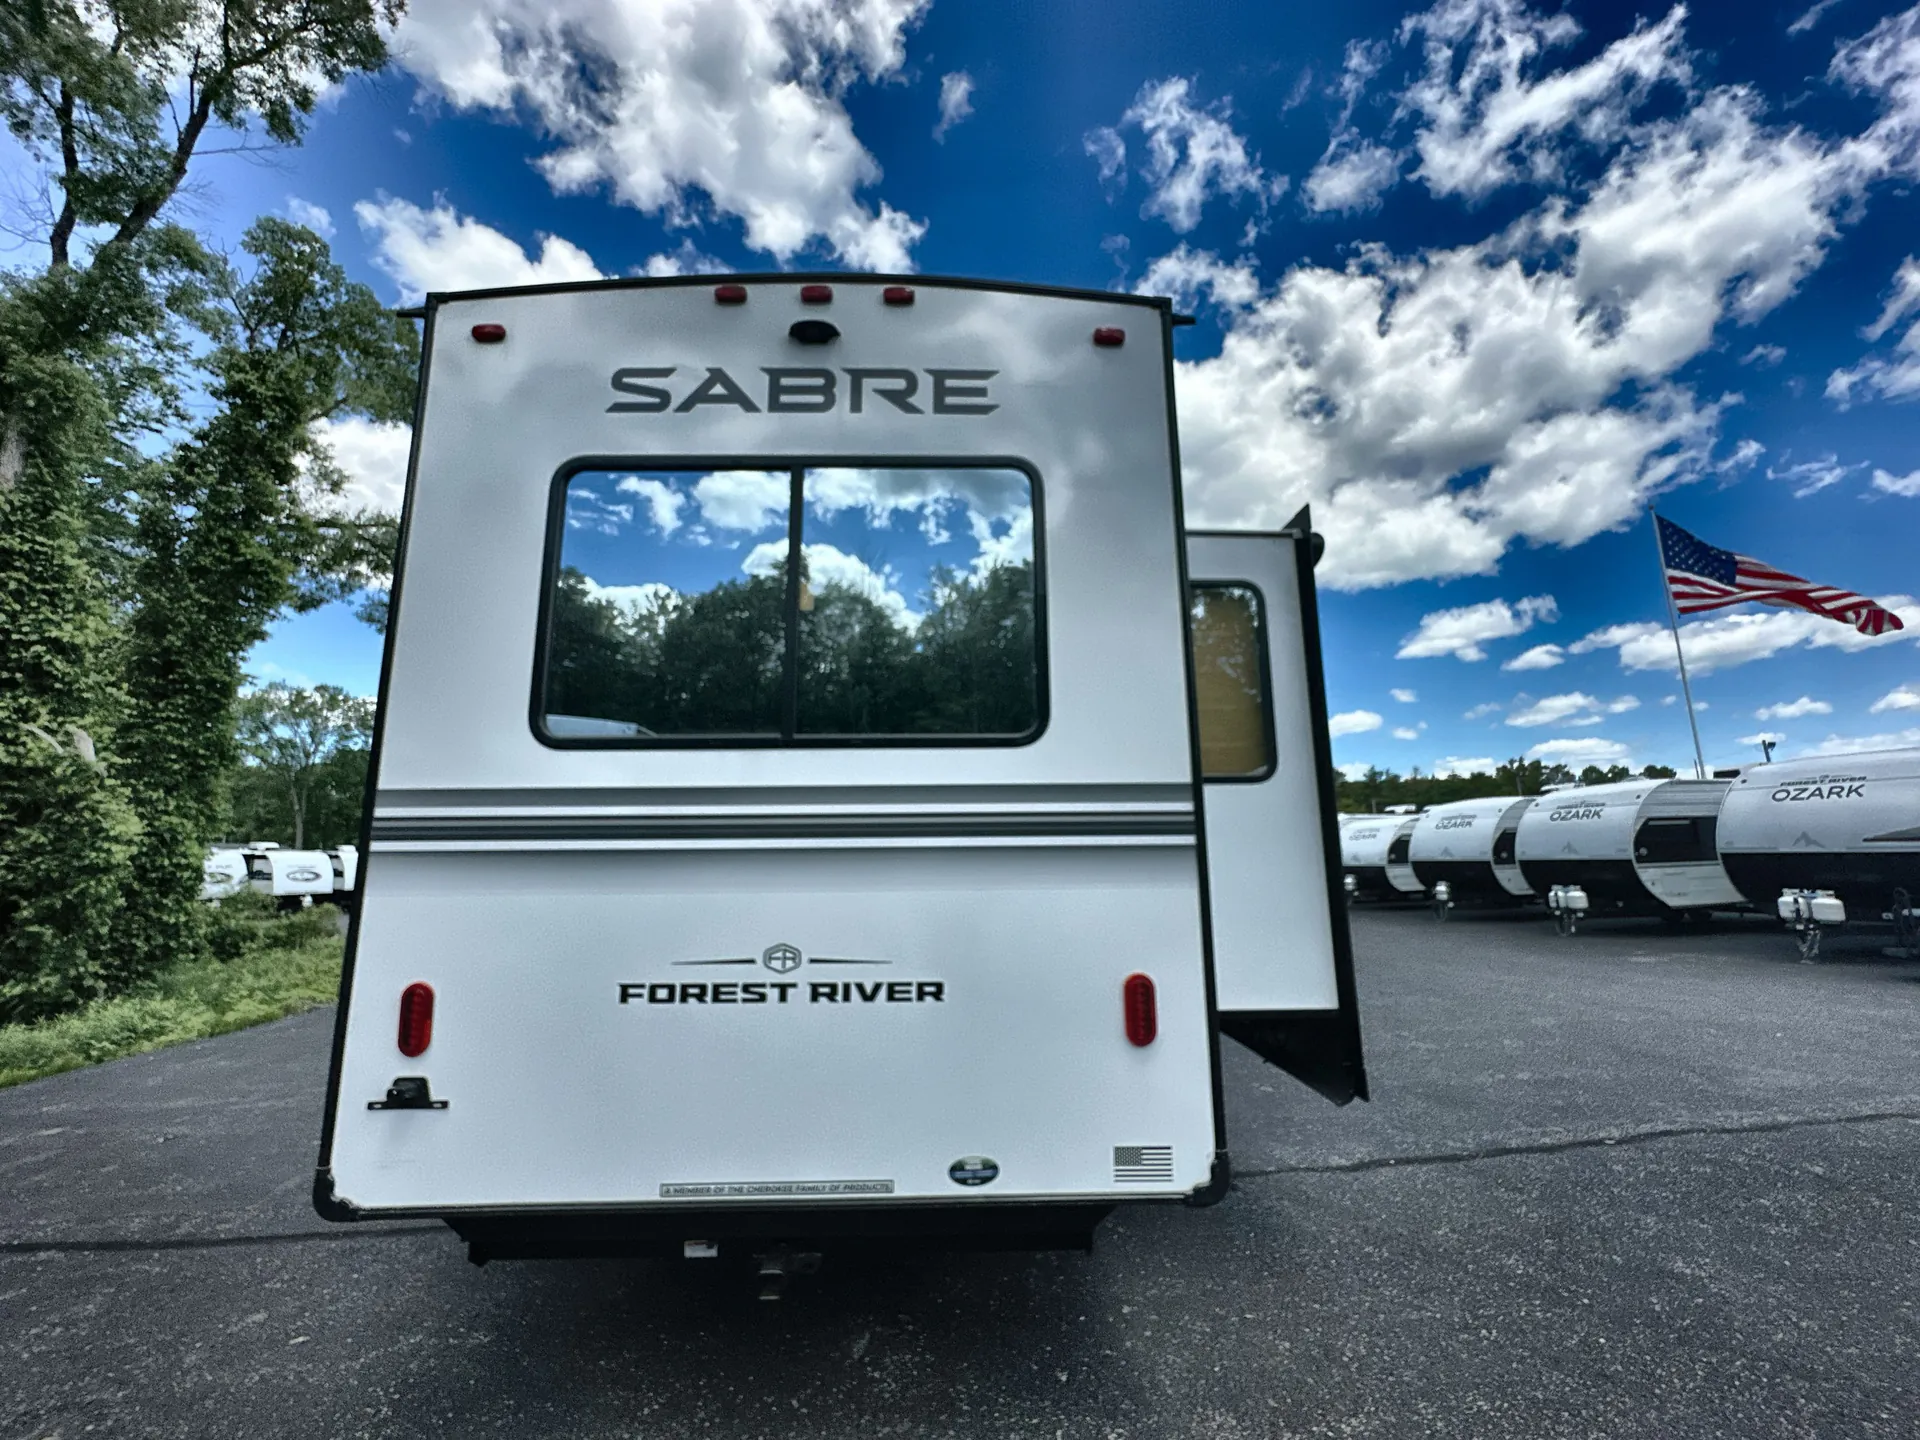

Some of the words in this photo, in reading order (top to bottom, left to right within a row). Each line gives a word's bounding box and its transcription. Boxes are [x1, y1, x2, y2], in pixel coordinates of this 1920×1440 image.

[605, 367, 1000, 415] SABRE
[1771, 783, 1865, 802] OZARK
[1549, 808, 1604, 822] OZARK
[618, 982, 798, 1004] FOREST
[808, 981, 945, 1003] RIVER
[674, 1186, 711, 1194] MEMBER
